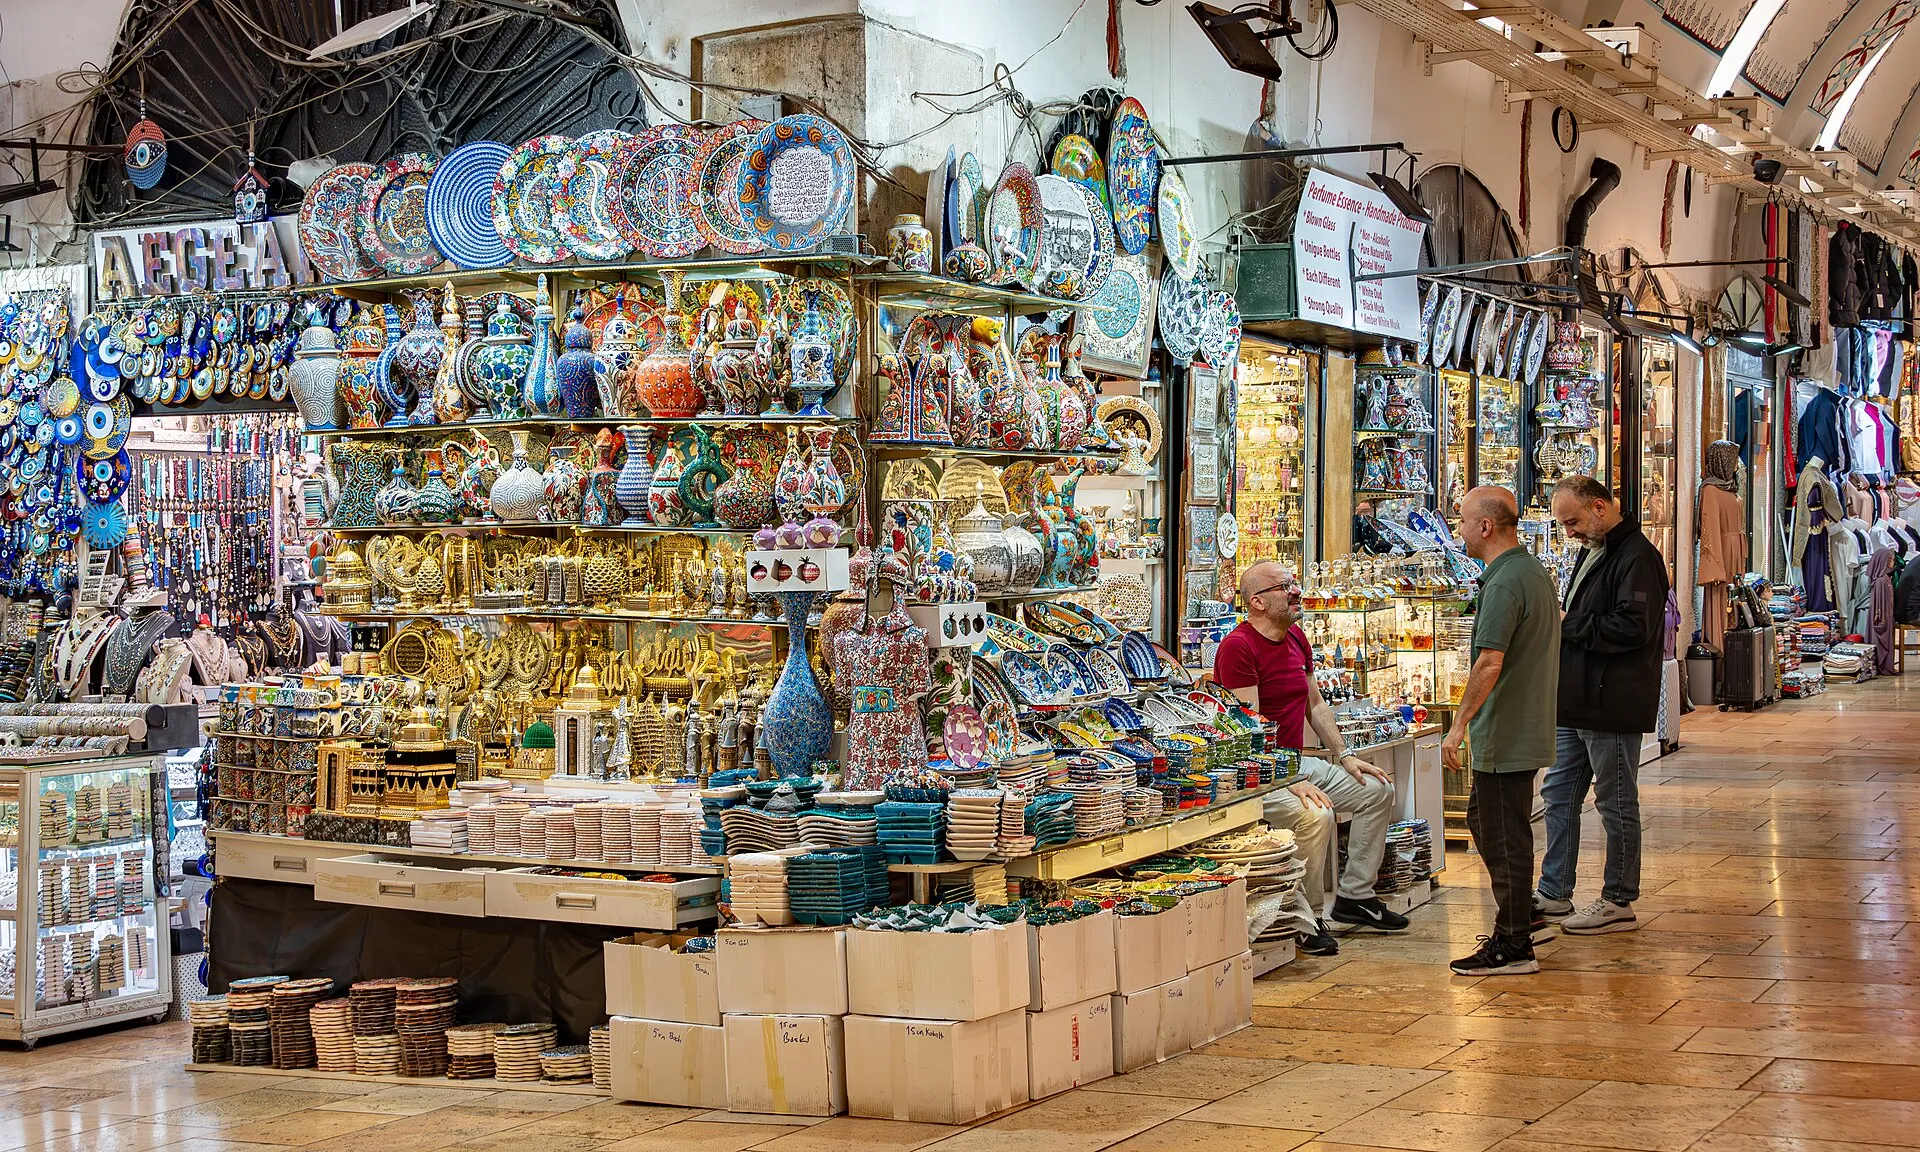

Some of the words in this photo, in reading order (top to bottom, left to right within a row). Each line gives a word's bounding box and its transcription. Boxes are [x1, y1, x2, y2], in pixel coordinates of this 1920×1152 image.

[1307, 181, 1337, 206] Perfume
[1336, 191, 1363, 215] Essence
[1364, 201, 1396, 226] Handmade
[1306, 210, 1322, 228] Blown
[1322, 216, 1336, 231] Glass
[98, 221, 315, 298] AEGEA
[1322, 244, 1341, 261] Bottles
[1306, 267, 1318, 283] Each
[1318, 271, 1341, 288] Different
[1308, 296, 1326, 316] Strong
[1326, 300, 1344, 319] Quality
